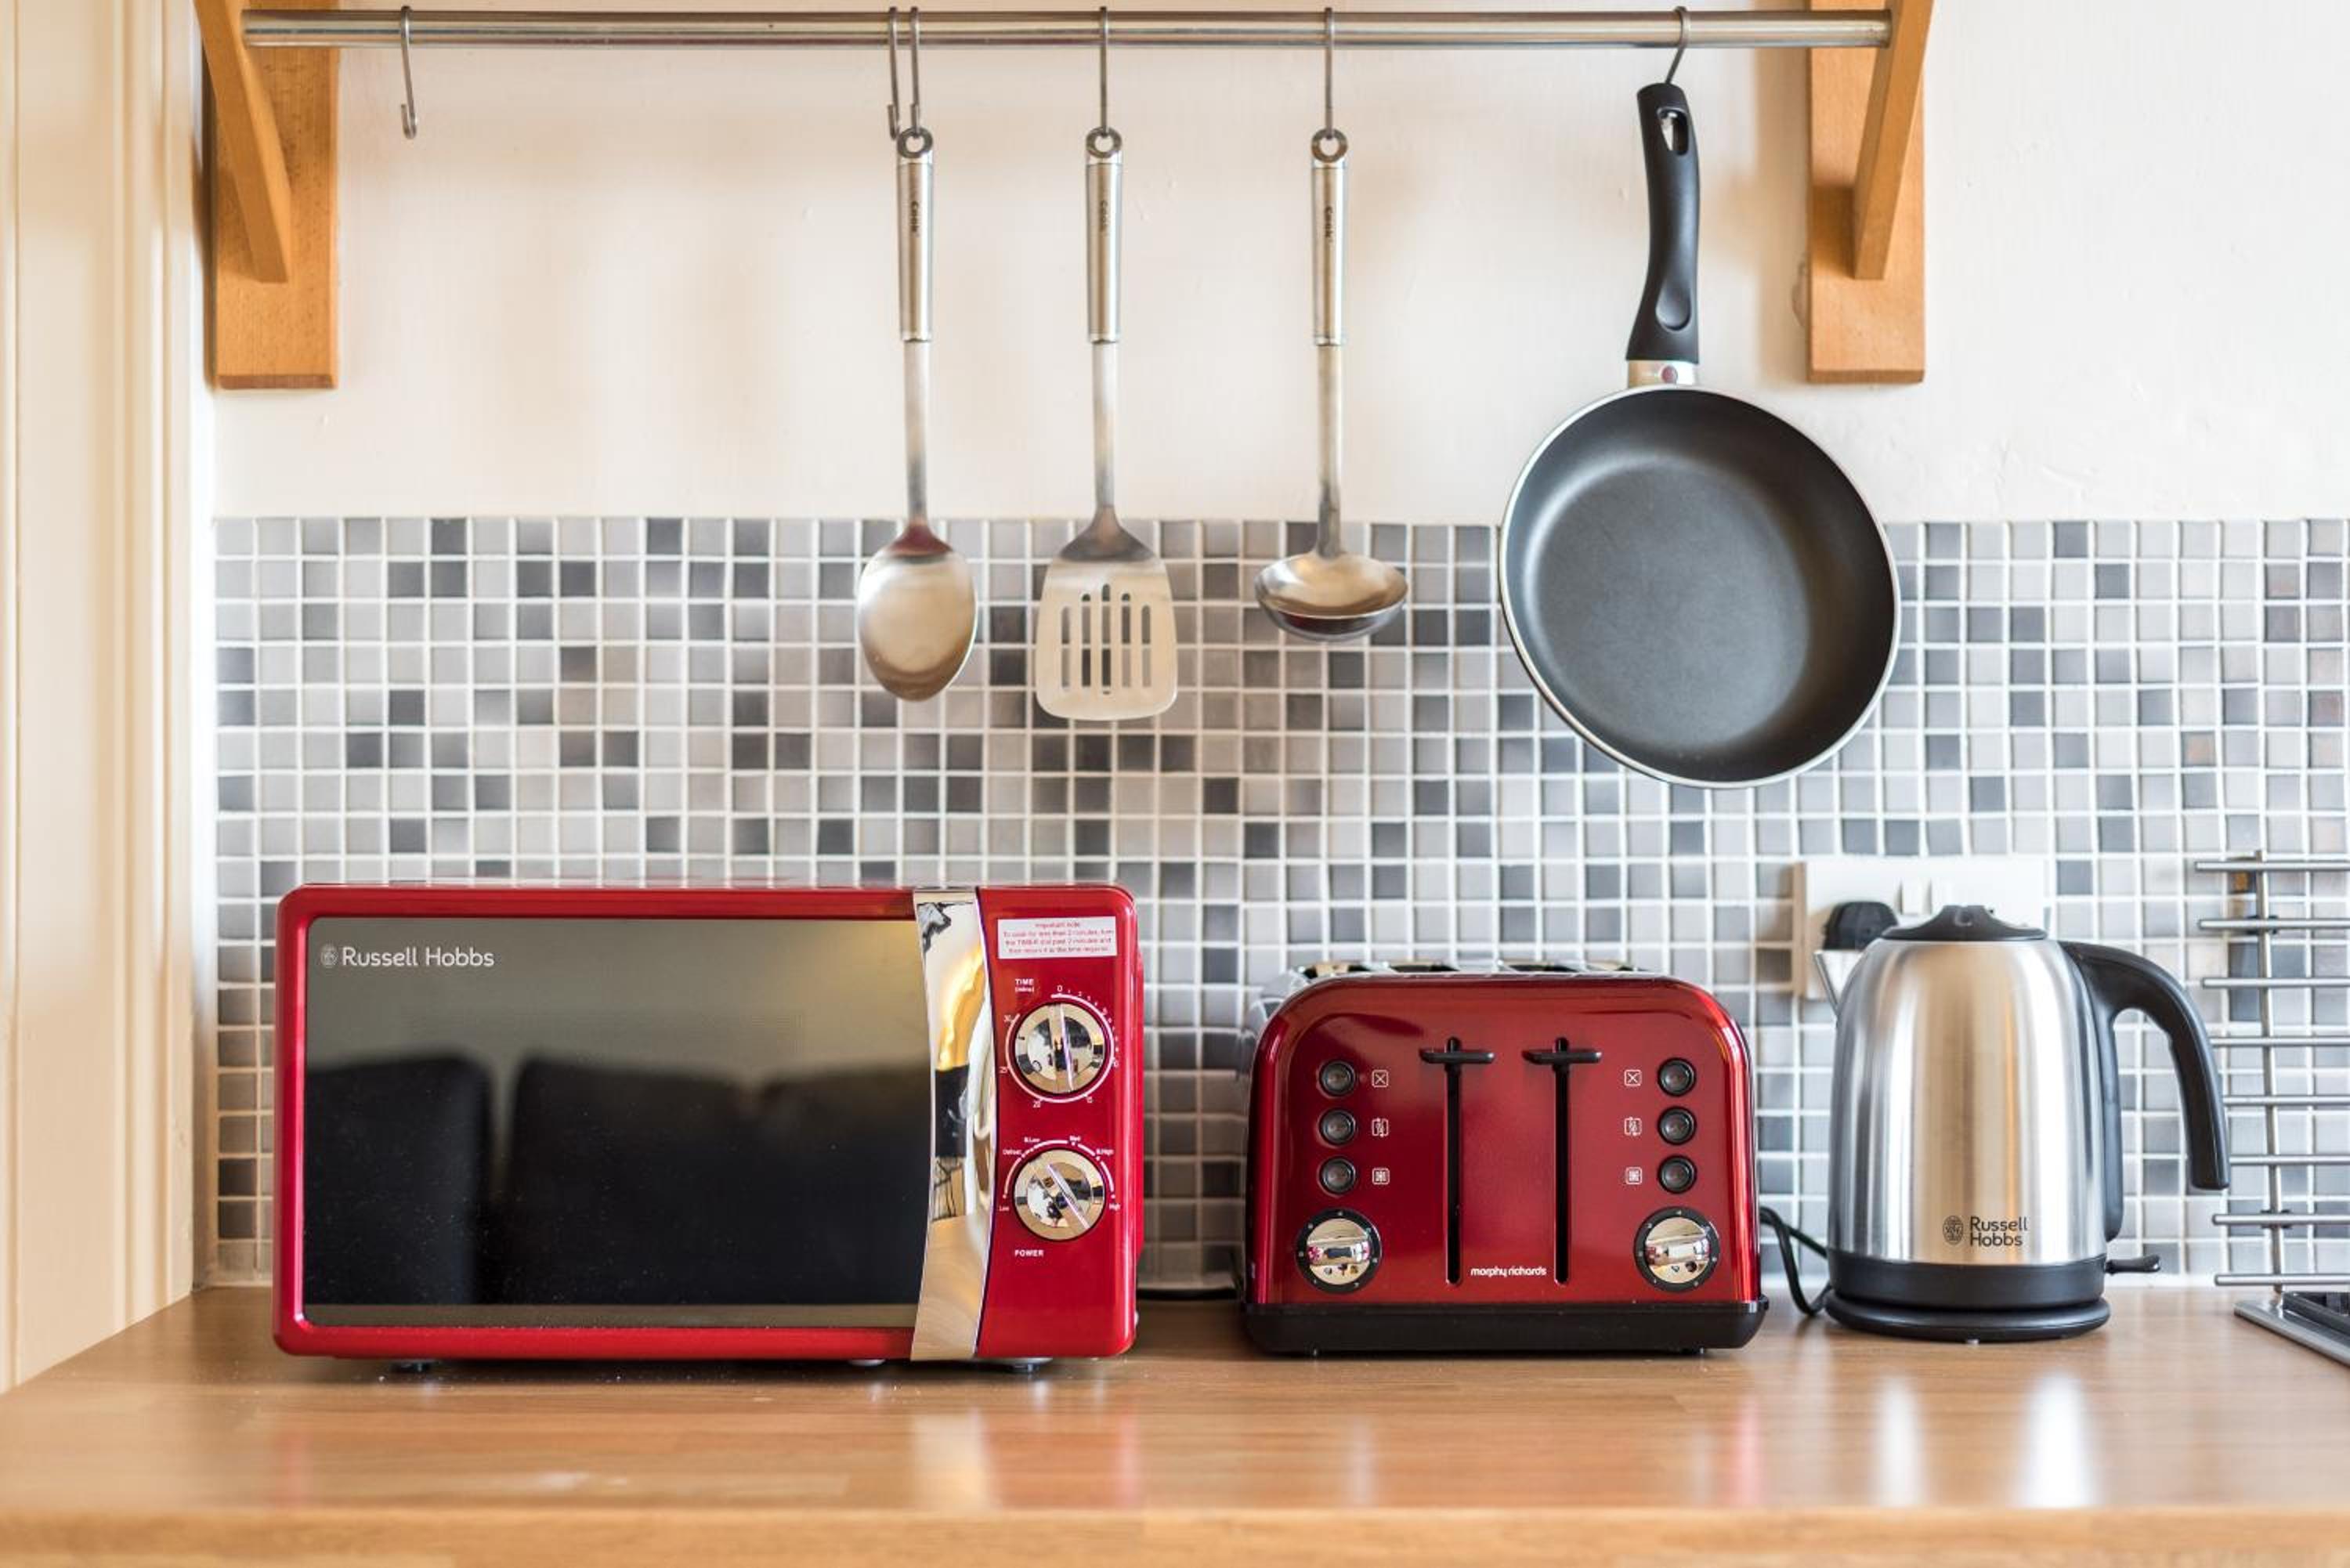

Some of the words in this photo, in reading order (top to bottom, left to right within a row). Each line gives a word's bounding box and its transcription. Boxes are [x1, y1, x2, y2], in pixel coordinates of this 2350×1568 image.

[342, 947, 418, 966] Russell
[425, 947, 495, 966] Hobbs
[1970, 1216, 2028, 1231] Russell
[1970, 1232, 2023, 1247] Hobbs
[1470, 1266, 1508, 1277] morphy
[1508, 1265, 1547, 1276] richards
